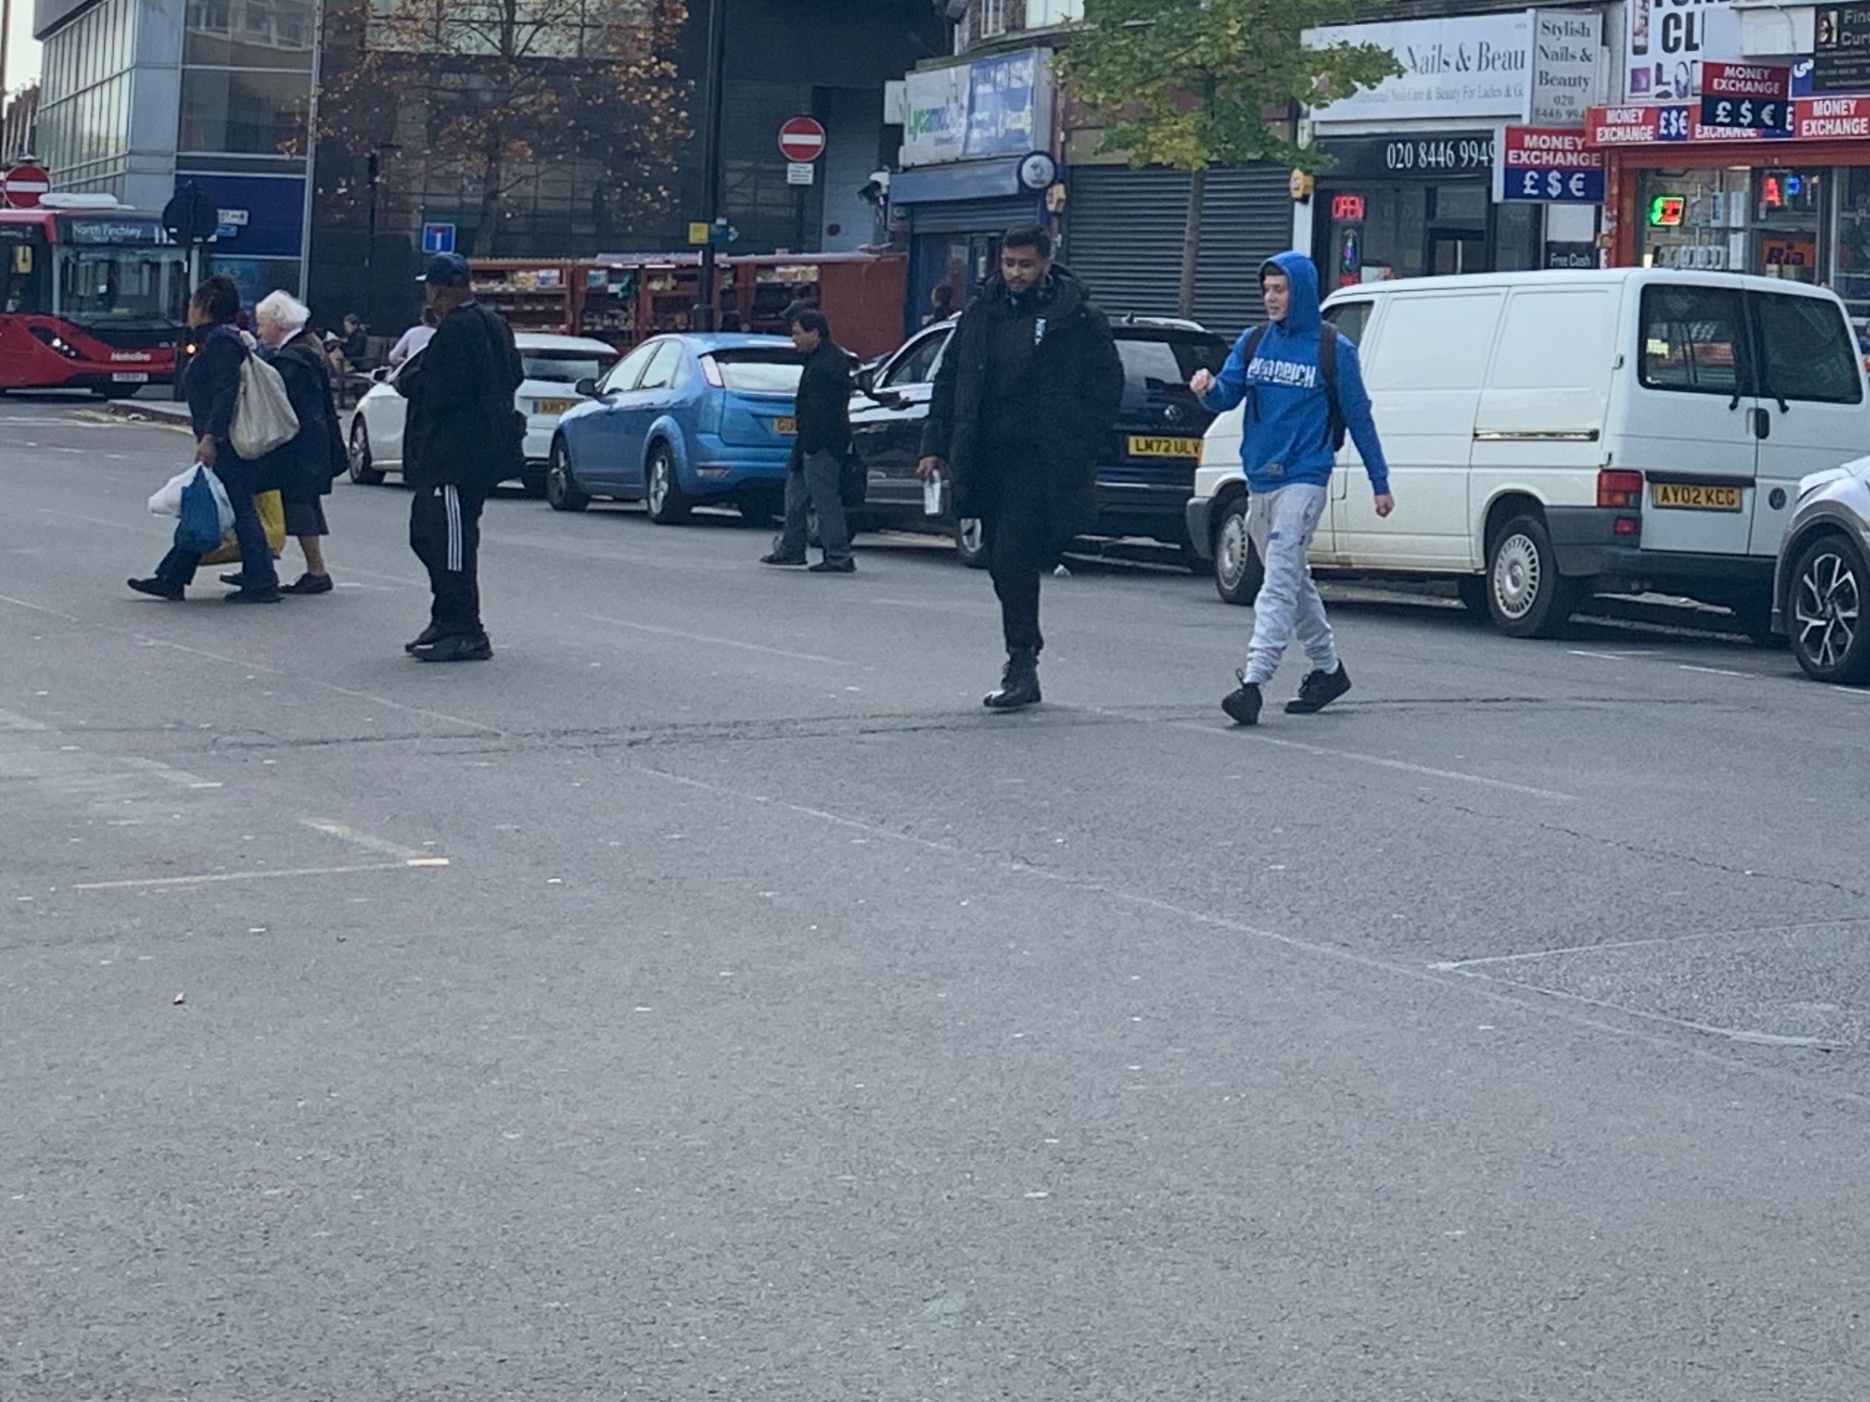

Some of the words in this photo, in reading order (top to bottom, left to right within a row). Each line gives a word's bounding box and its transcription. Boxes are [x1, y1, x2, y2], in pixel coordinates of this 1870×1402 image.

[1541, 19, 1591, 41] Stylish
[1662, 11, 1704, 54] CL
[1406, 44, 1451, 75] Nails
[1455, 41, 1472, 73] &
[1477, 41, 1526, 72] Beau
[1539, 44, 1577, 62] Nails
[1580, 47, 1593, 63] &
[1539, 70, 1591, 93] Beauty
[1723, 66, 1771, 80] MONEY
[1712, 78, 1780, 95] EXCHANGE
[1553, 94, 1575, 106] 020
[1812, 99, 1857, 117] MONEY
[1606, 108, 1645, 124] MONEY
[1596, 125, 1655, 143] EXCHANGE
[1801, 117, 1869, 136] EXCHANGE
[1523, 135, 1587, 151] MONEY
[1386, 142, 1414, 170] 020
[1418, 141, 1456, 169] 8446
[1459, 140, 1495, 168] 9949
[1507, 150, 1602, 167] EXCHANGE
[72, 223, 101, 235] North
[103, 222, 142, 239] Finchley
[1569, 252, 1591, 267] Cash
[1766, 242, 1805, 265] Ria
[1661, 486, 1702, 504] AY02
[1705, 488, 1736, 506] KCG
